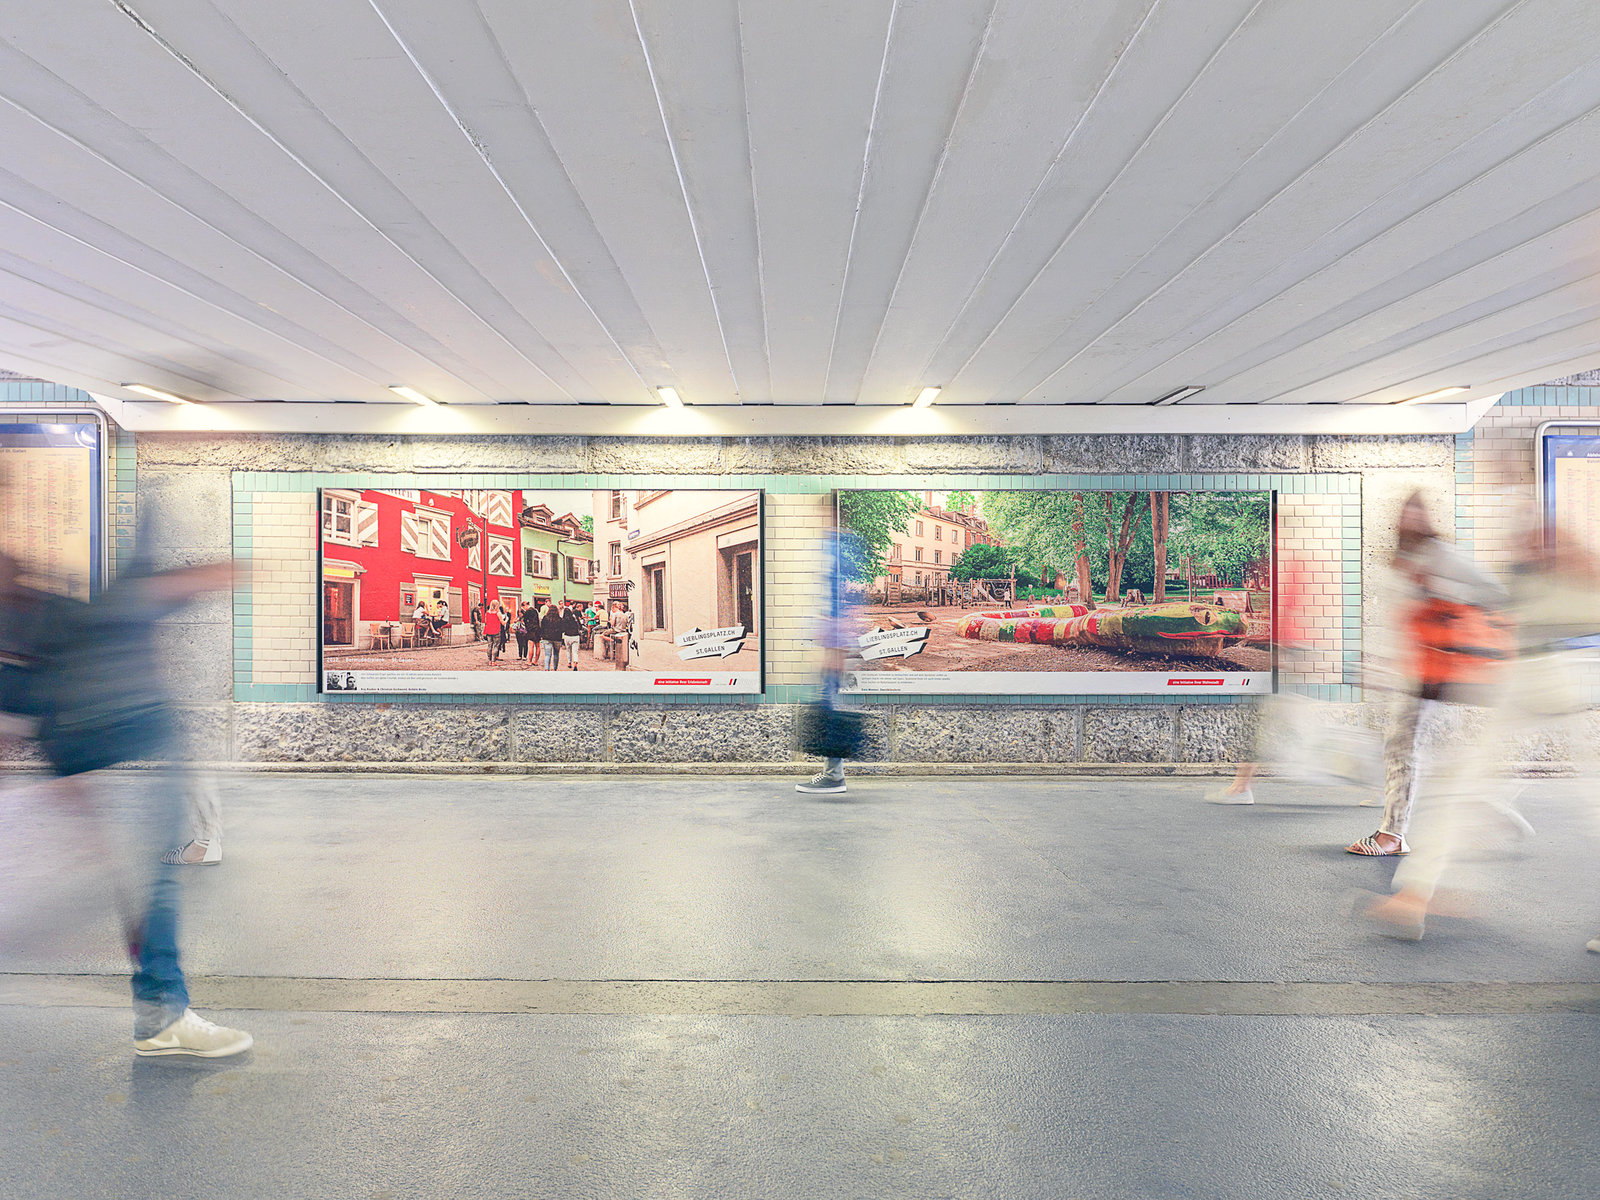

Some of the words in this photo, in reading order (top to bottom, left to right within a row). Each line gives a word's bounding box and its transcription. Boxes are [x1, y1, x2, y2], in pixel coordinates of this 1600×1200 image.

[682, 630, 736, 643] LIEBLINGSPLATZ.CH
[865, 630, 919, 643] LIEBLINGSPLATZ.CH
[695, 645, 726, 655] ST.GALLEN
[879, 646, 908, 655] ST.GALLEN
